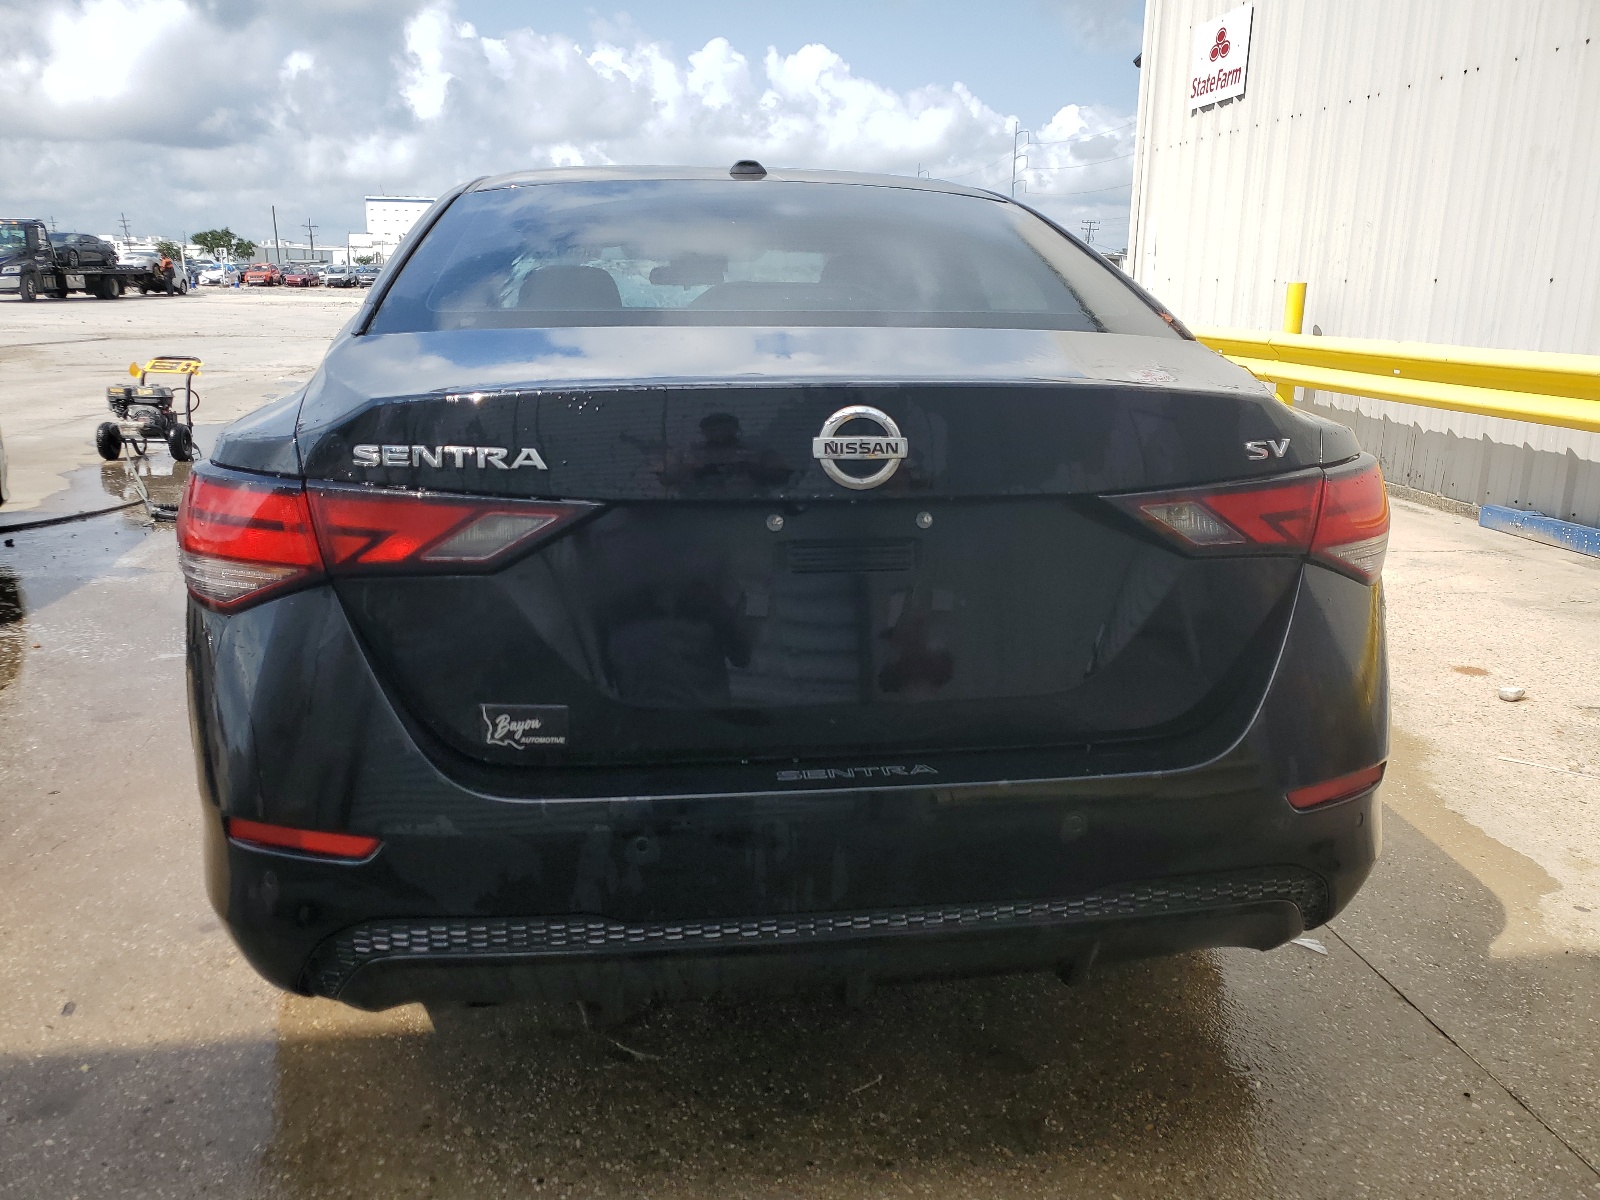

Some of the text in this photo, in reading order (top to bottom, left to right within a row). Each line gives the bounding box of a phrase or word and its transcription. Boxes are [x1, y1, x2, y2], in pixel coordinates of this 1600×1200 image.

[352, 443, 548, 470] SENTRA
[824, 442, 899, 455] NISSAN
[1245, 438, 1291, 460] SV
[494, 714, 541, 740] Bayou
[520, 736, 566, 744] AUTOMOTIVE
[776, 764, 939, 781] SENTRA
